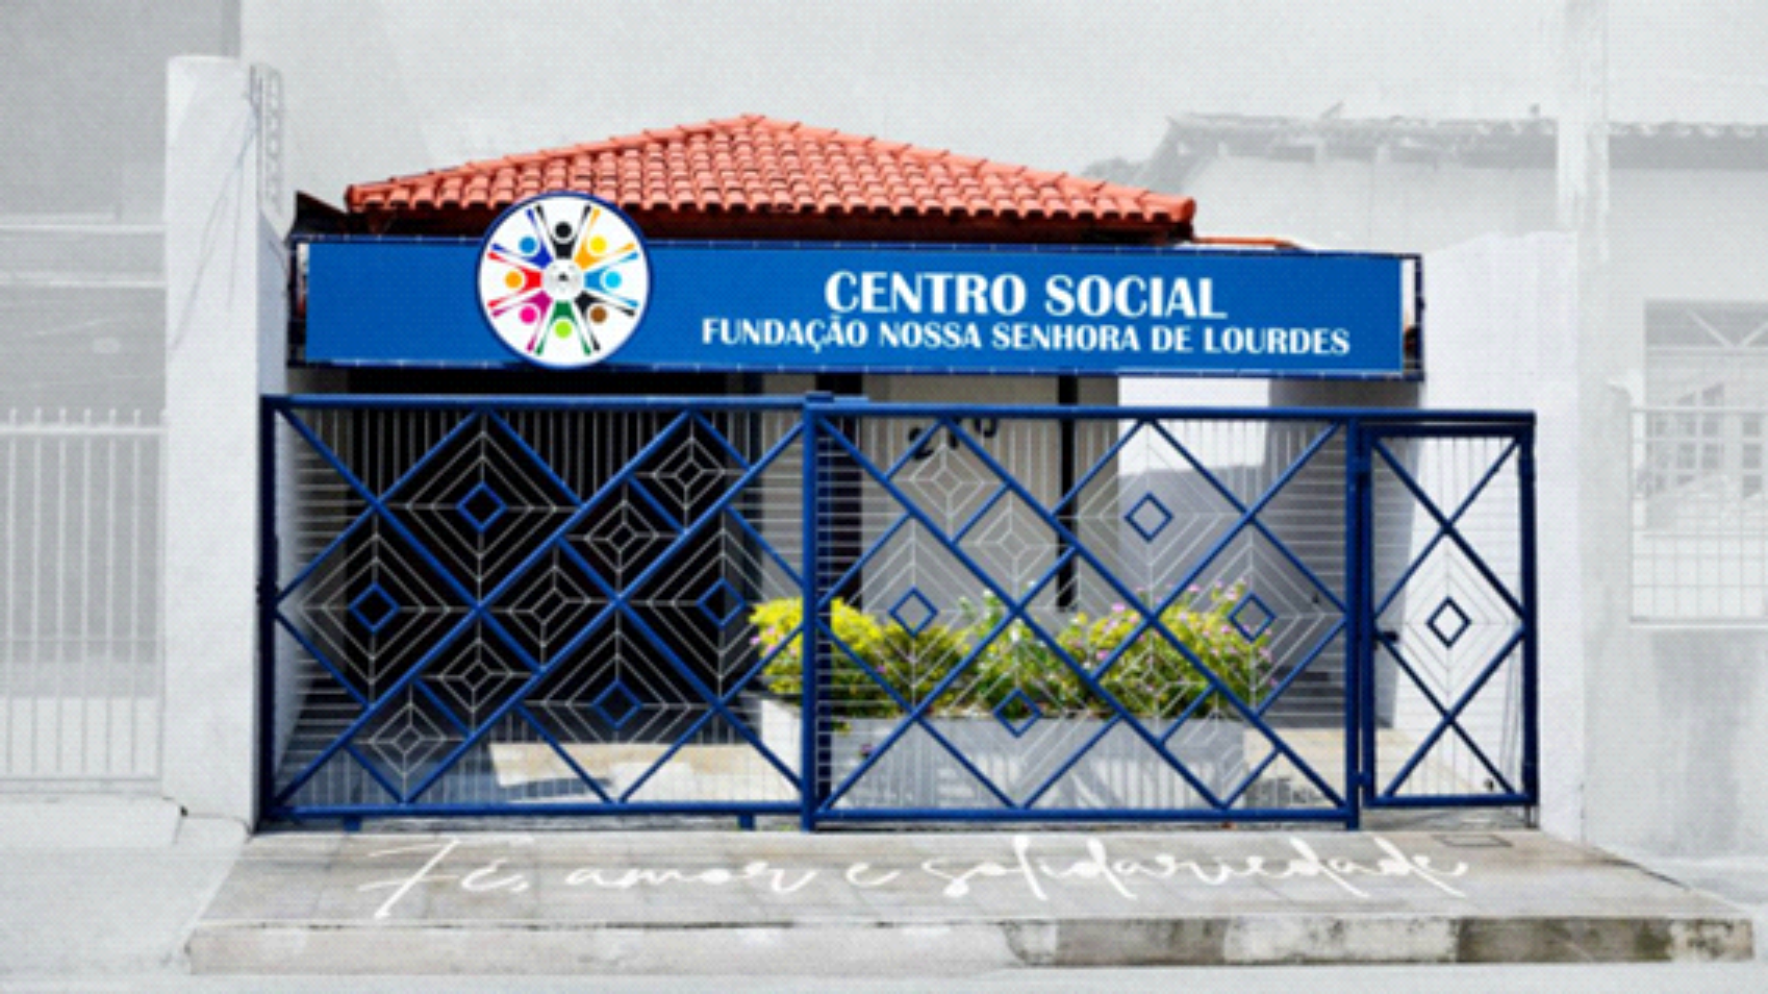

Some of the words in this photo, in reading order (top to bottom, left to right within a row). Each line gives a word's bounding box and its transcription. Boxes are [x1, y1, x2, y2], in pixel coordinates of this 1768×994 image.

[825, 271, 1026, 317] CENTRO
[1044, 275, 1228, 320] SOCIAL
[701, 315, 869, 353] FUNDAÇÃO
[879, 321, 982, 349] NOSSA
[992, 324, 1141, 352] SENHORA
[1151, 326, 1193, 353] DE
[1203, 328, 1351, 356] LOURDES
